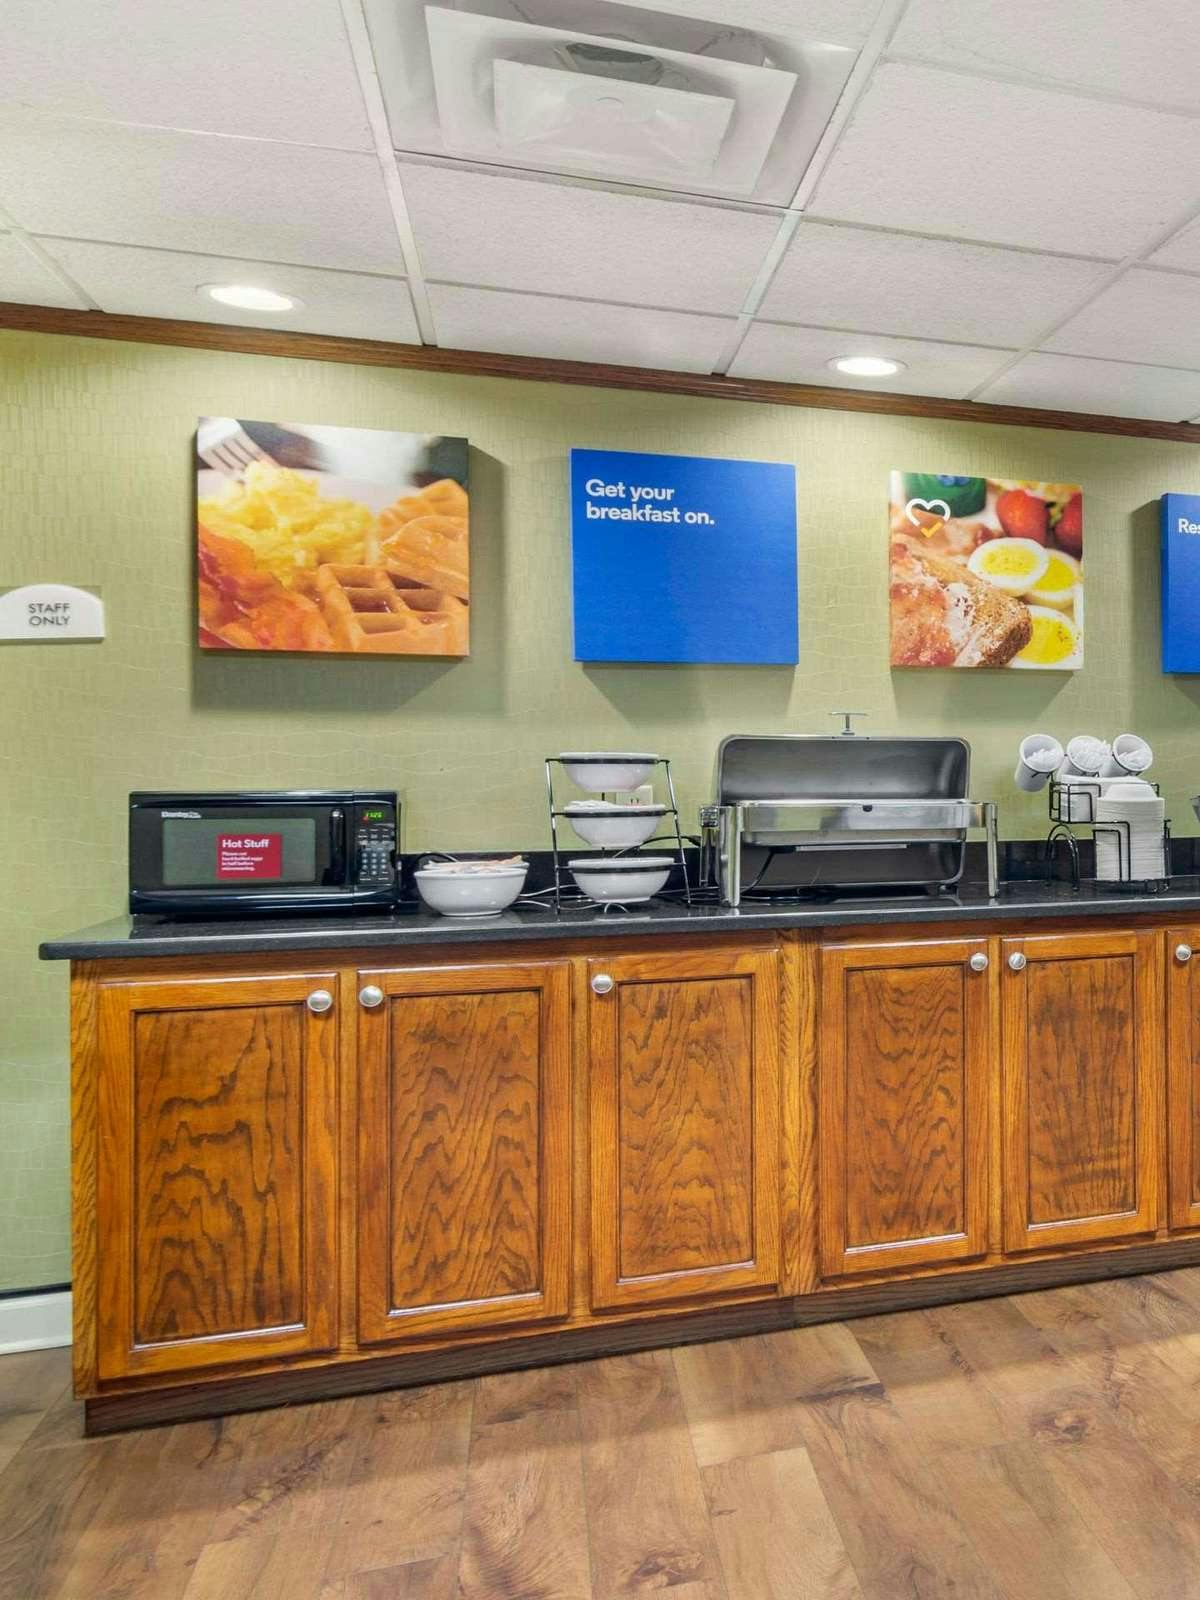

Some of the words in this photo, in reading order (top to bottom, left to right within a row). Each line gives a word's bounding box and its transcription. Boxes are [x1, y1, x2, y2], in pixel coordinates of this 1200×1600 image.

[585, 479, 625, 498] Get
[630, 485, 675, 502] your
[586, 501, 680, 524] breakfast
[684, 511, 715, 525] on.
[28, 603, 70, 613] STAFF
[28, 616, 70, 626] ONLY
[222, 839, 242, 848] Hot
[244, 839, 270, 848] Stuff
